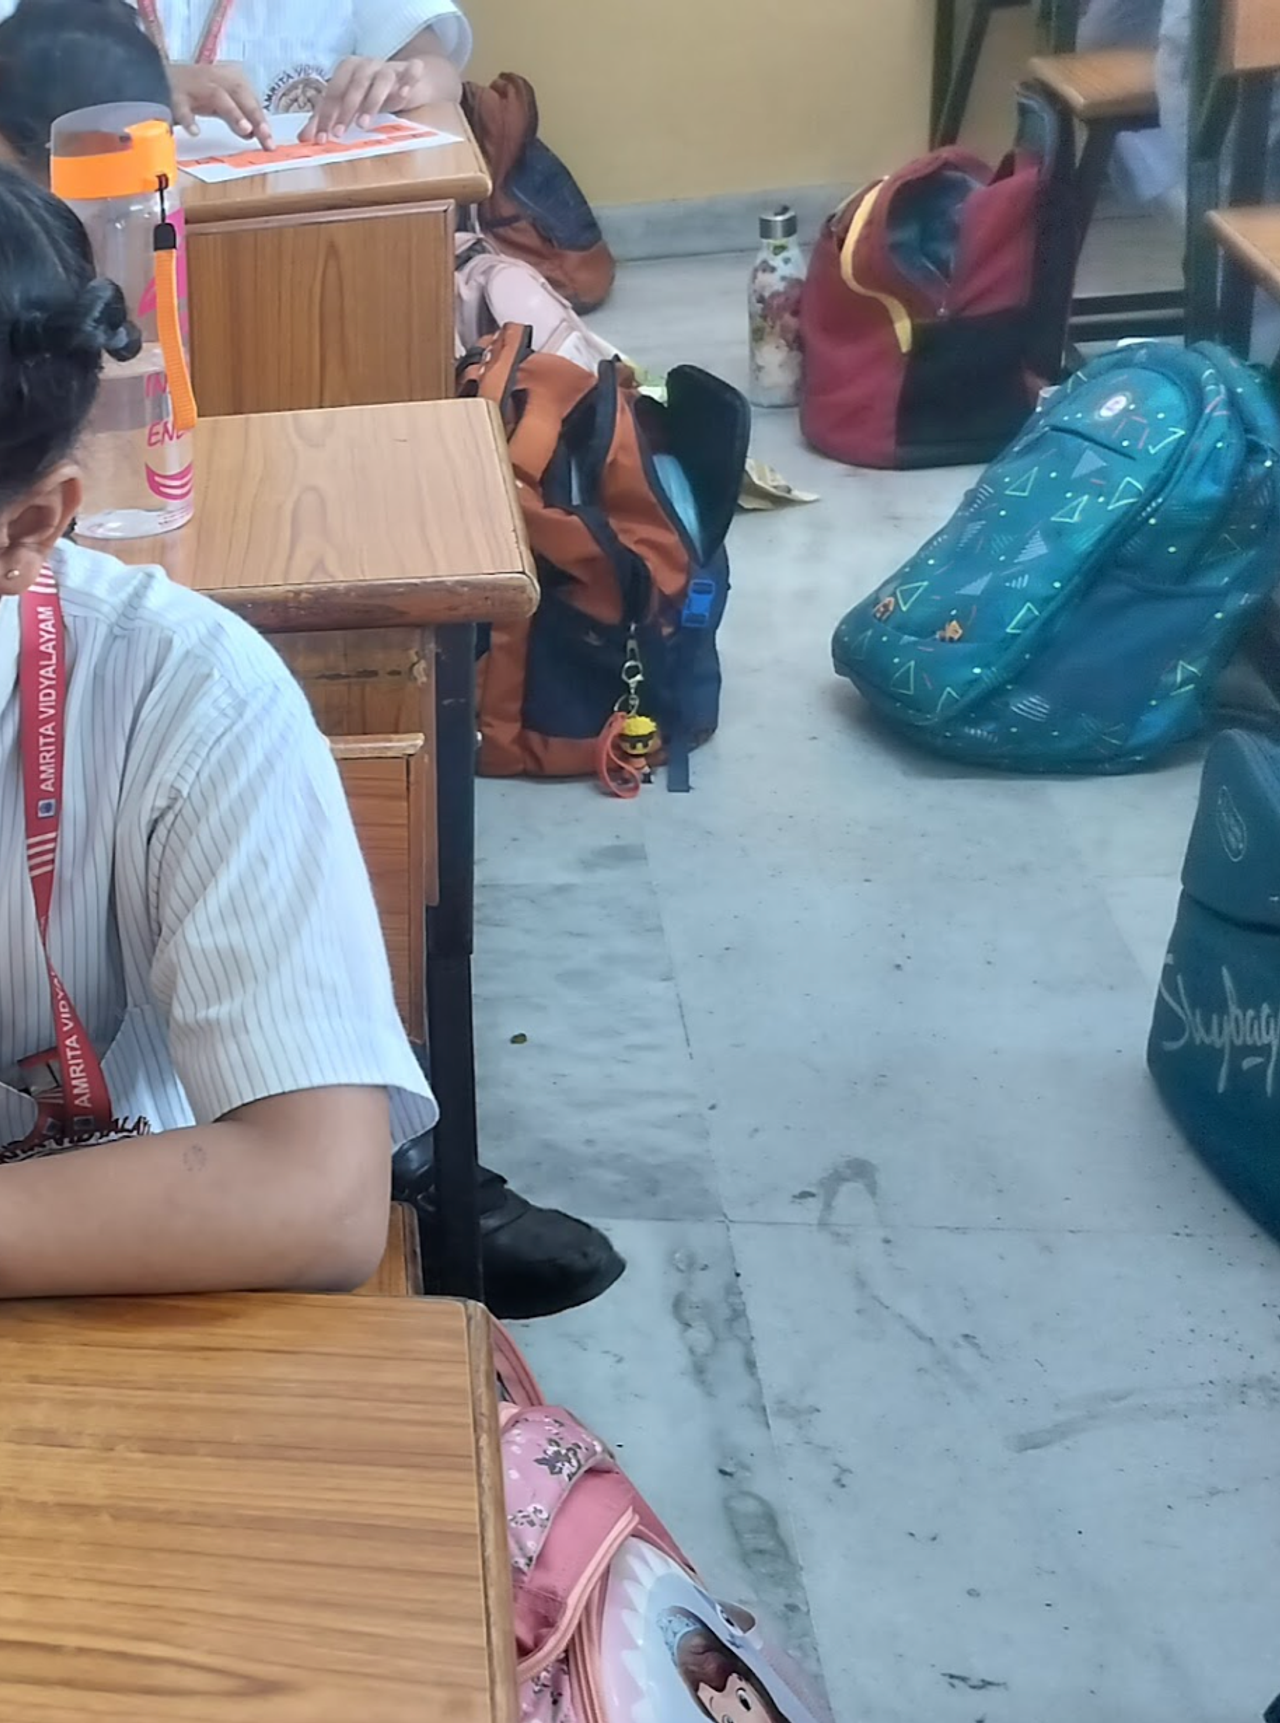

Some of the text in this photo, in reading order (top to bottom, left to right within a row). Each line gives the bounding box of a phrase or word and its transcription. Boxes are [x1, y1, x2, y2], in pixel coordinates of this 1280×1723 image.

[37, 606, 57, 792] AMRITA VIDYALAYAM
[63, 1034, 93, 1108] AMRITA
